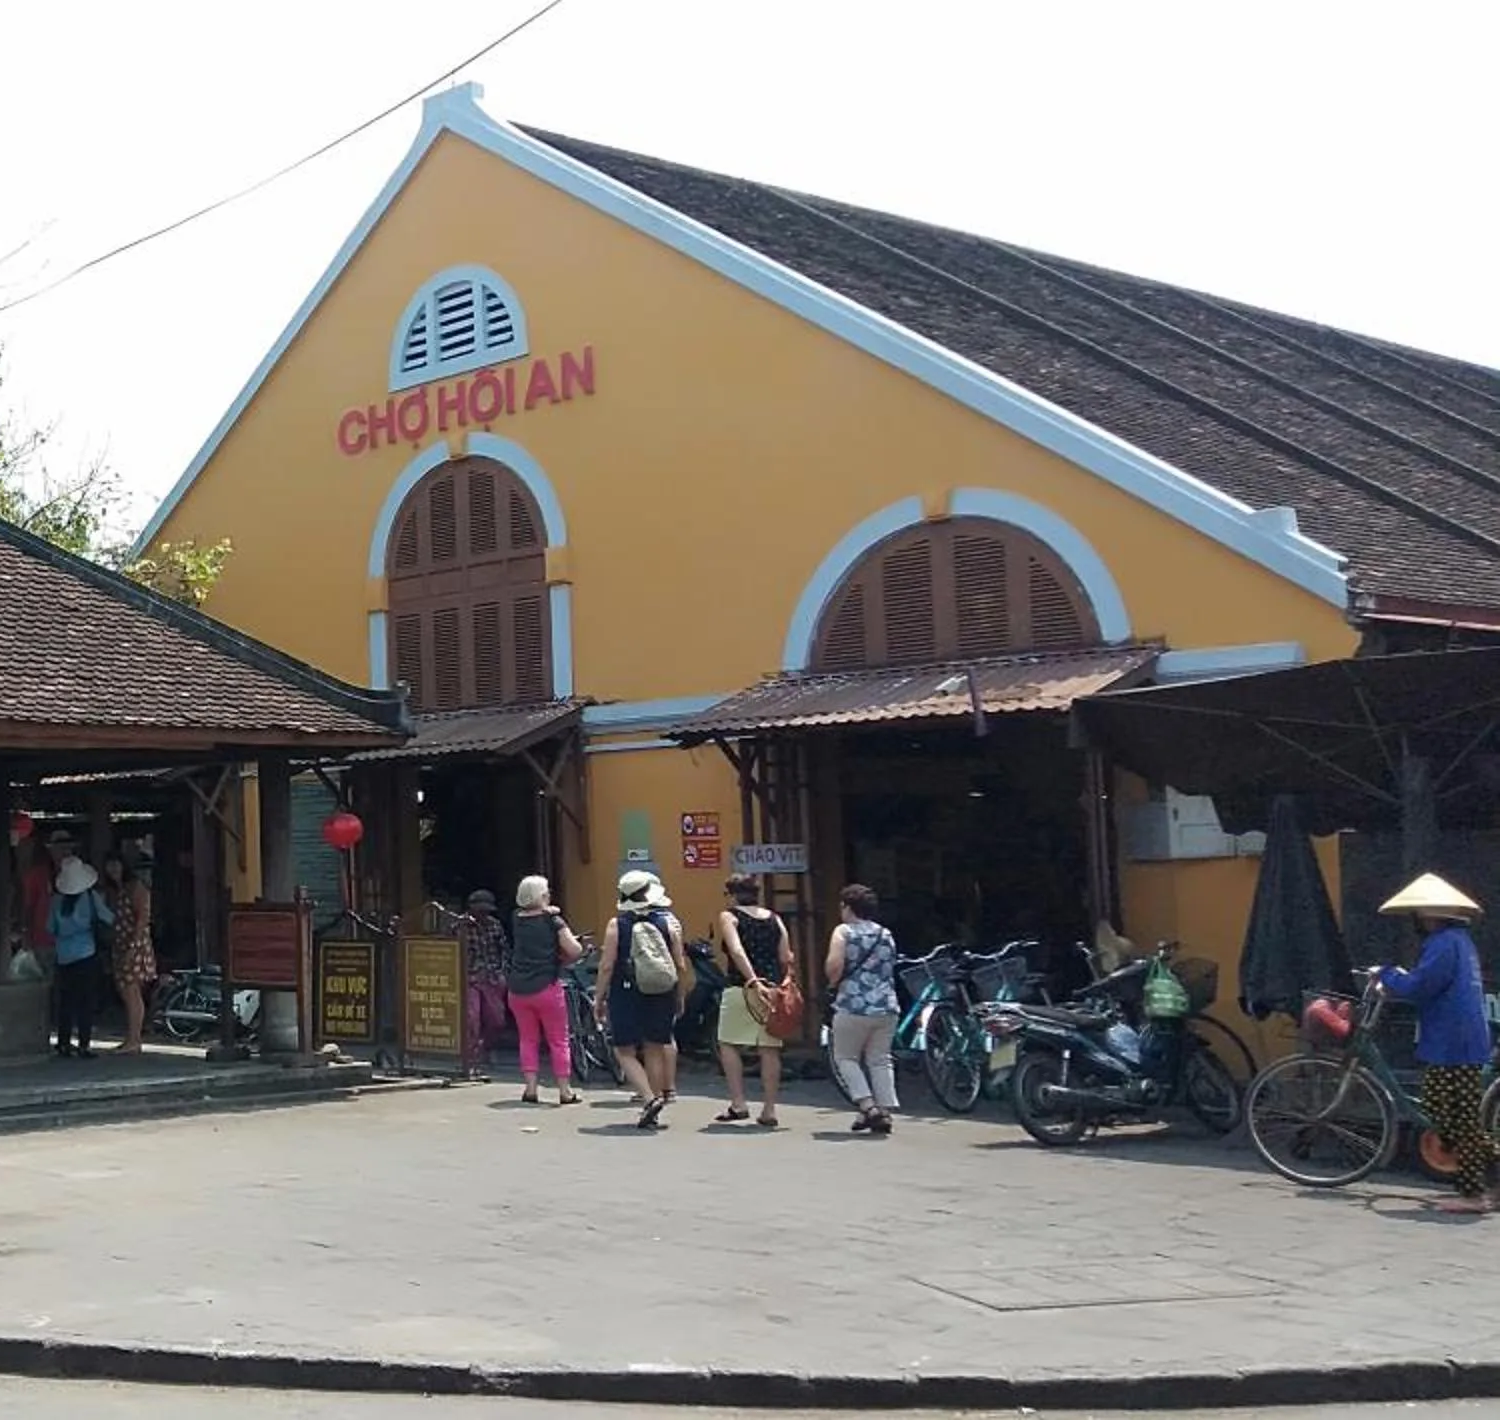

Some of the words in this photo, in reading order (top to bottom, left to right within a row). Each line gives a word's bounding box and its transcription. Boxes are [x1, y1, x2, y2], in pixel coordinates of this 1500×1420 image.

[337, 384, 429, 457] CHỢ
[436, 366, 516, 432] HỘI
[523, 345, 596, 411] AN
